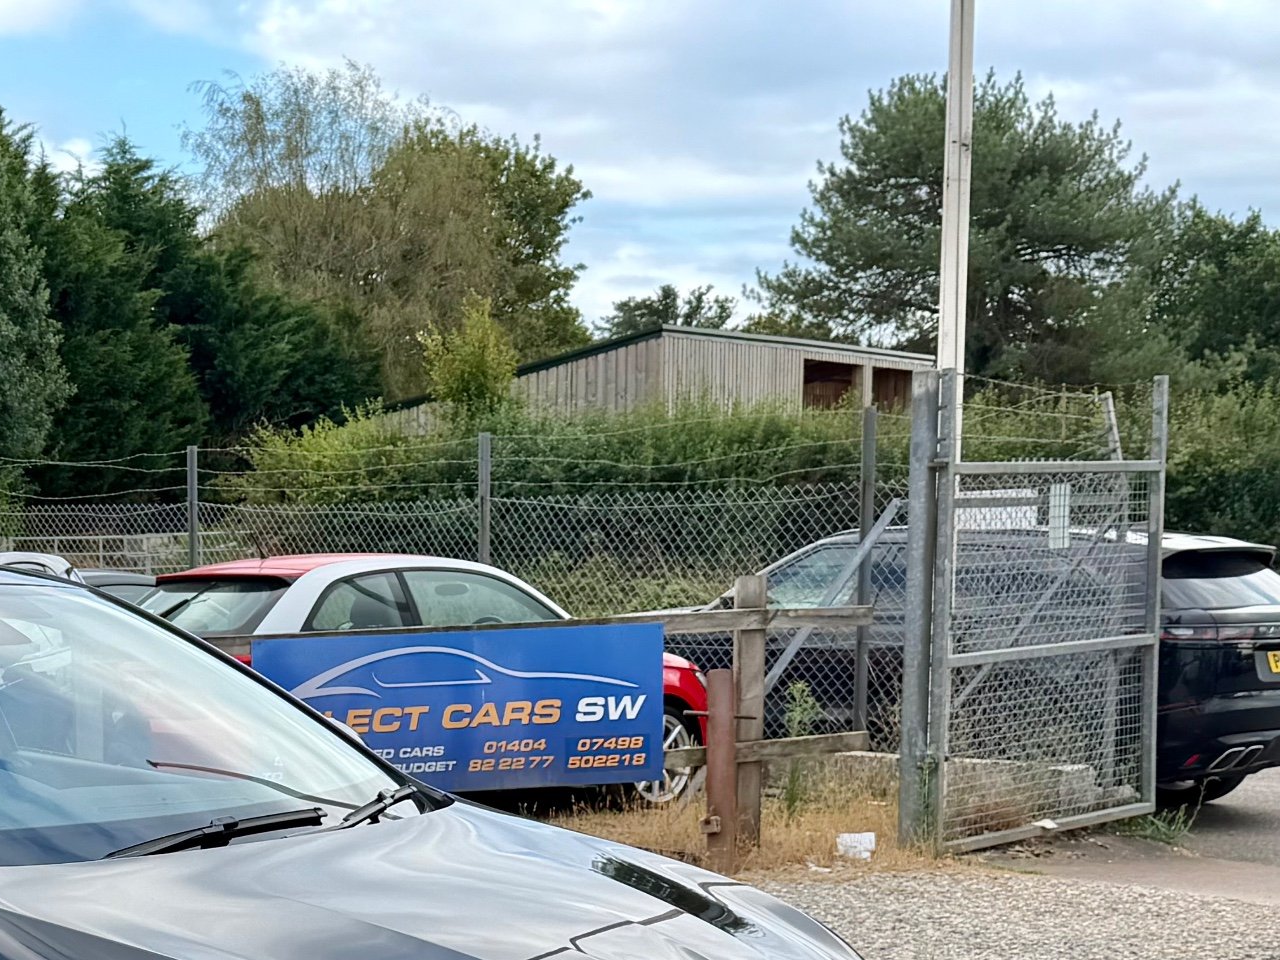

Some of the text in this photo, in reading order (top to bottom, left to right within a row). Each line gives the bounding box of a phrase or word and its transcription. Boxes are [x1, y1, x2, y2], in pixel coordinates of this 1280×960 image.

[442, 698, 562, 730] CARS
[575, 694, 647, 722] SW
[399, 745, 444, 758] CARS
[483, 738, 547, 755] 01404
[577, 735, 644, 752] 07498
[567, 752, 646, 769] 502218
